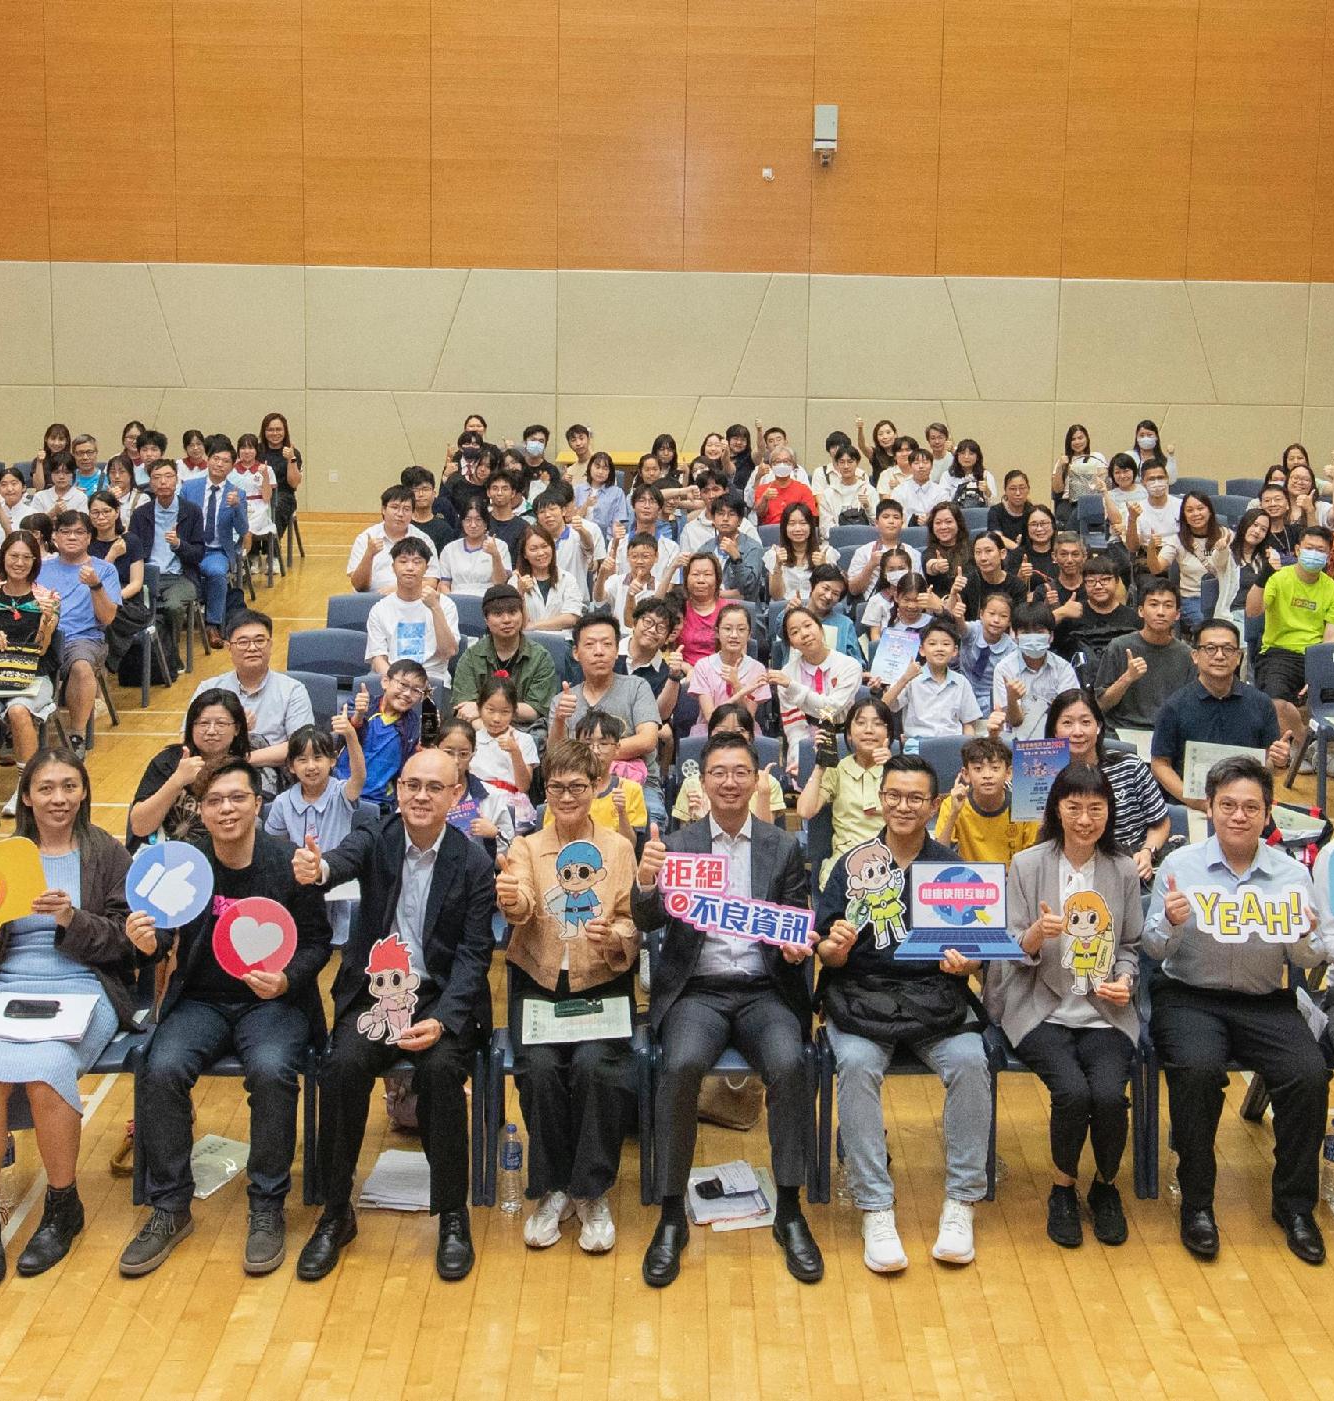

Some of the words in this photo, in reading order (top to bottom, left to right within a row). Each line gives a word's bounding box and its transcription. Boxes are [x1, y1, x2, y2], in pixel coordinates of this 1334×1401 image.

[665, 859, 723, 889] 拒絕
[689, 894, 809, 945] 不良資訊
[1193, 891, 1303, 936] YEAH!
